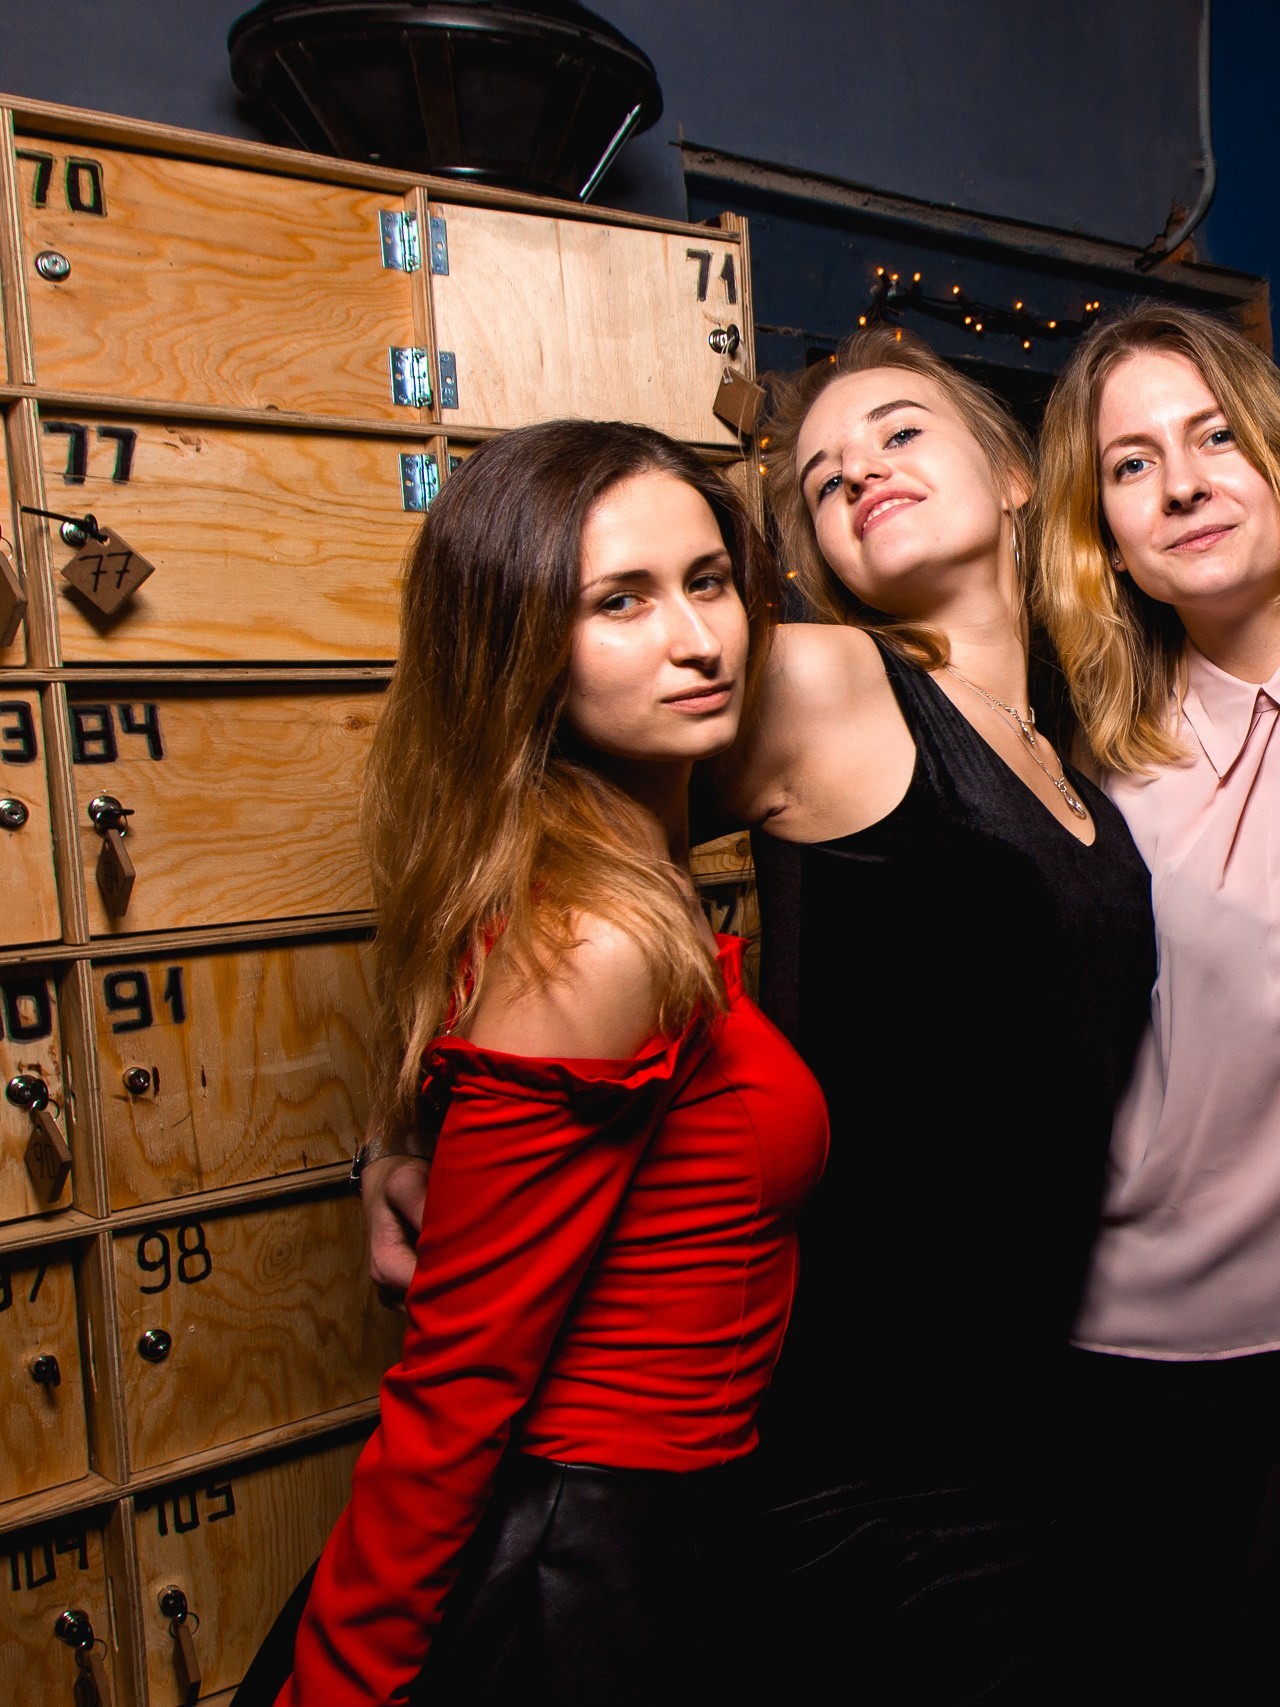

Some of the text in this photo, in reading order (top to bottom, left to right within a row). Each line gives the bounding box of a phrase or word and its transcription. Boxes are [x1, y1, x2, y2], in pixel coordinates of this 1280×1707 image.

[15, 149, 107, 217] 70
[687, 248, 738, 305] 71
[44, 422, 138, 484] 77
[78, 551, 133, 592] 77
[72, 703, 165, 765] 84
[104, 966, 186, 1034] 91
[137, 1224, 212, 1294] 98
